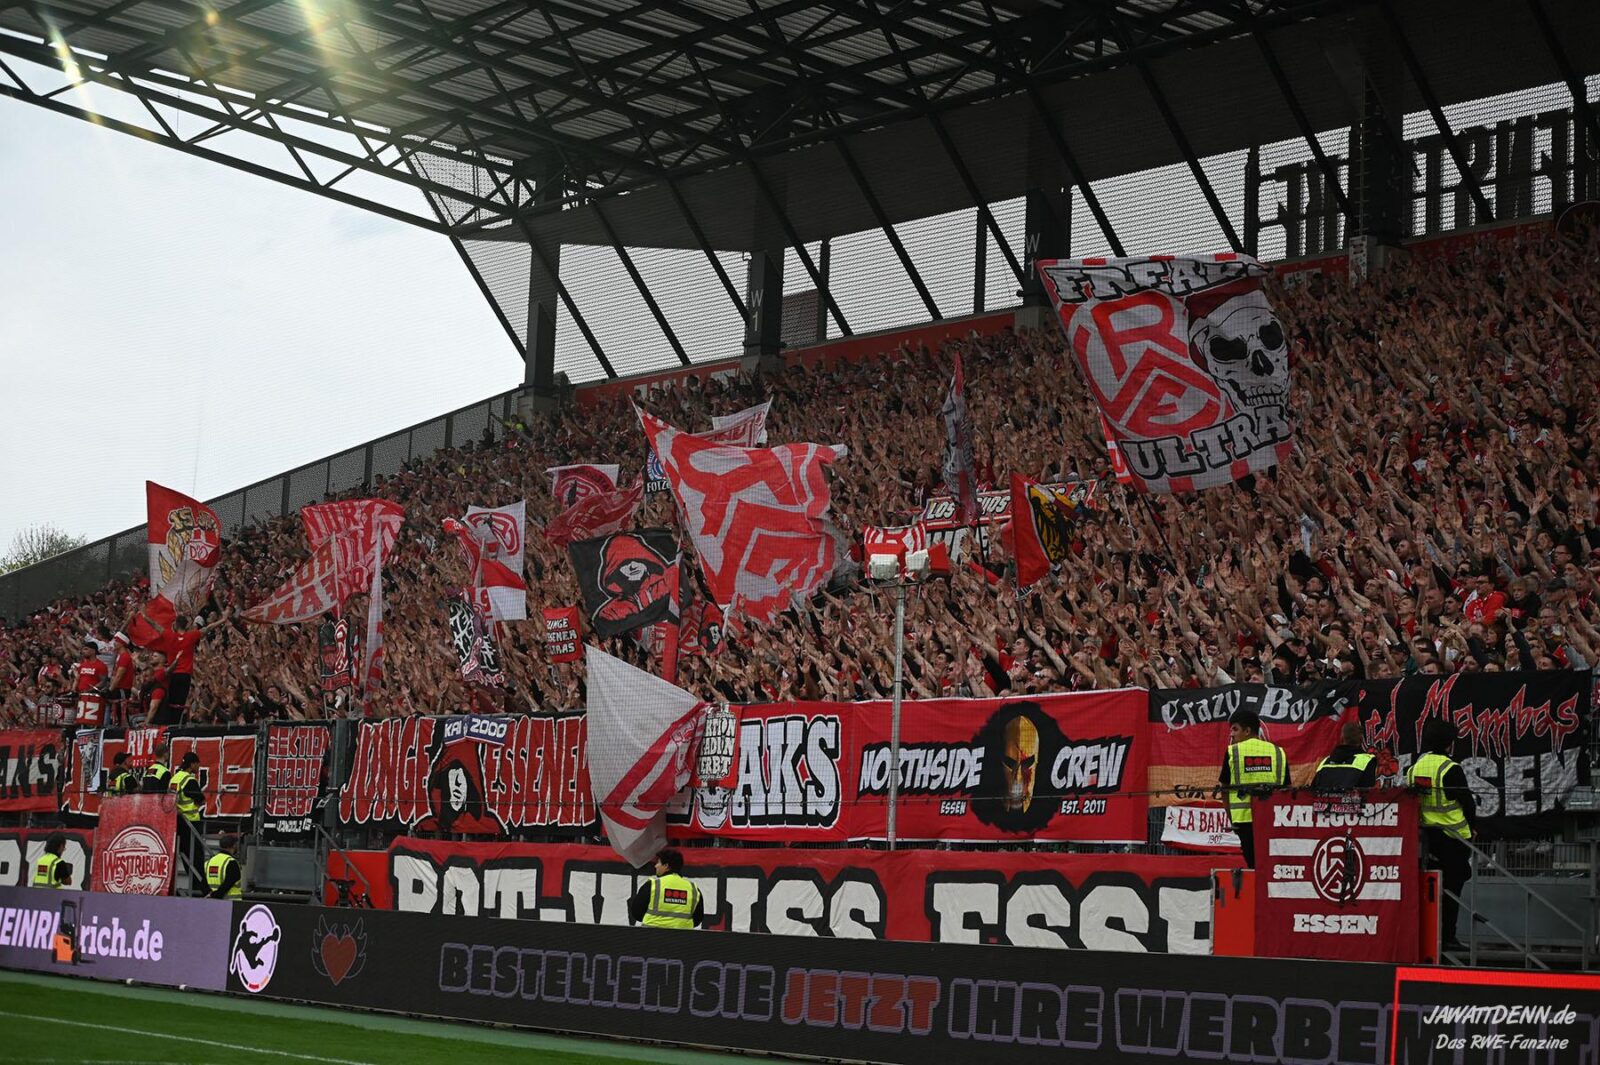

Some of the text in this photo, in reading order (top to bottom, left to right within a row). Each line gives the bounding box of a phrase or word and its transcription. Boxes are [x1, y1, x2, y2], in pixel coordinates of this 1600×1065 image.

[1026, 233, 1041, 253] W
[751, 289, 764, 308] W
[752, 311, 759, 332] 1
[1121, 404, 1292, 480] ULTRA
[927, 501, 956, 519] LOS
[470, 717, 508, 738] 2000
[339, 717, 437, 824] JUNGE
[859, 743, 1127, 794] NORTHSIDE CREW
[940, 800, 967, 816] ESSEN
[1061, 799, 1106, 814] EST. 2011
[1178, 809, 1196, 832] LA
[1273, 864, 1400, 880] SEIT 2015
[933, 882, 1213, 954] ESSE
[1293, 913, 1379, 935] ESSEN
[439, 943, 684, 1013] BESTELLEN
[689, 960, 776, 1022] SIE
[781, 967, 942, 1036] JETZT
[948, 978, 1105, 1050] IHRE
